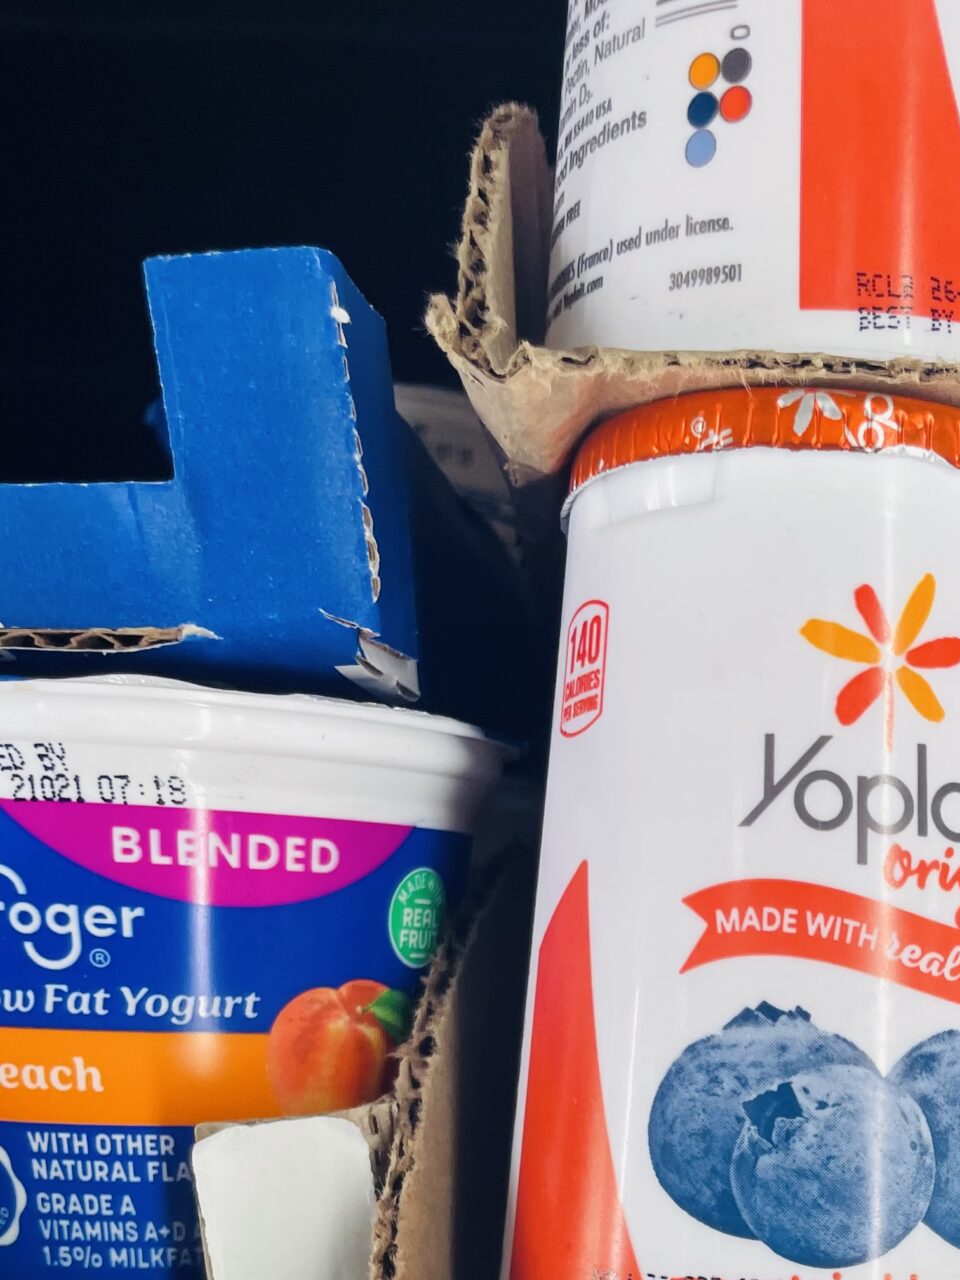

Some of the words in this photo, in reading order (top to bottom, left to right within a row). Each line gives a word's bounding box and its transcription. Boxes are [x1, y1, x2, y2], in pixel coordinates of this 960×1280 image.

[593, 16, 646, 67] Natural
[568, 110, 648, 174] Ingredients
[616, 226, 642, 256] used
[645, 218, 682, 246] under
[684, 213, 734, 238] license.
[668, 262, 743, 292] 3049989501
[569, 614, 603, 675] 140
[563, 667, 601, 703] CALORIES
[111, 826, 340, 874] BLENDED
[402, 906, 439, 929] REAL
[714, 905, 798, 936] MADE
[805, 910, 880, 952] WITH
[0, 902, 146, 971] oger
[399, 928, 440, 950] FRUIT
[44, 983, 111, 1016] Fat
[119, 986, 261, 1027] Yogurt
[0, 1055, 105, 1093] each
[27, 1130, 89, 1156] WITH
[95, 1132, 176, 1157] OTHER
[31, 1158, 142, 1184] NATURAL
[146, 1161, 193, 1184] FLA
[36, 1192, 115, 1217] GRADE
[119, 1194, 137, 1217] A
[39, 1218, 139, 1243] VITAMINS
[144, 1221, 187, 1244] A+D
[42, 1245, 104, 1269] 1.5%
